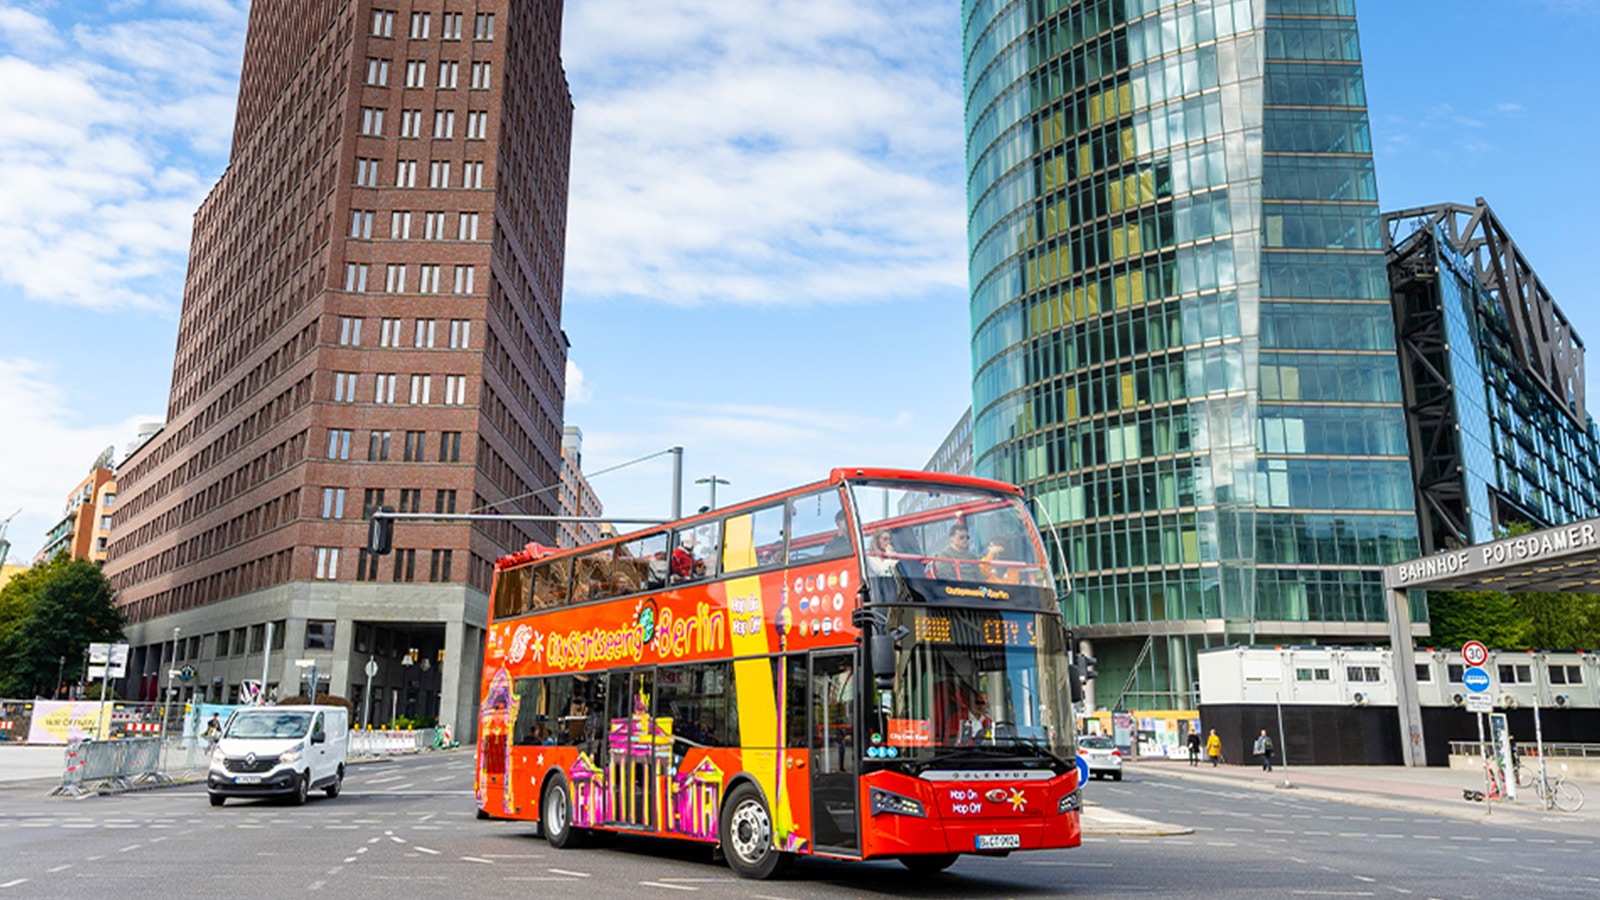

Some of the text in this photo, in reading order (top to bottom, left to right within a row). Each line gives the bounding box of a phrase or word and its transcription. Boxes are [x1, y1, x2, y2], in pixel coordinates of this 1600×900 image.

[1399, 524, 1597, 582] BAHNHOF POTSDAMER
[658, 601, 725, 659] Berlin
[984, 619, 1018, 644] CITY
[1468, 647, 1482, 660] 30
[950, 788, 978, 801] Hop On
[952, 802, 982, 815] Hop Off
